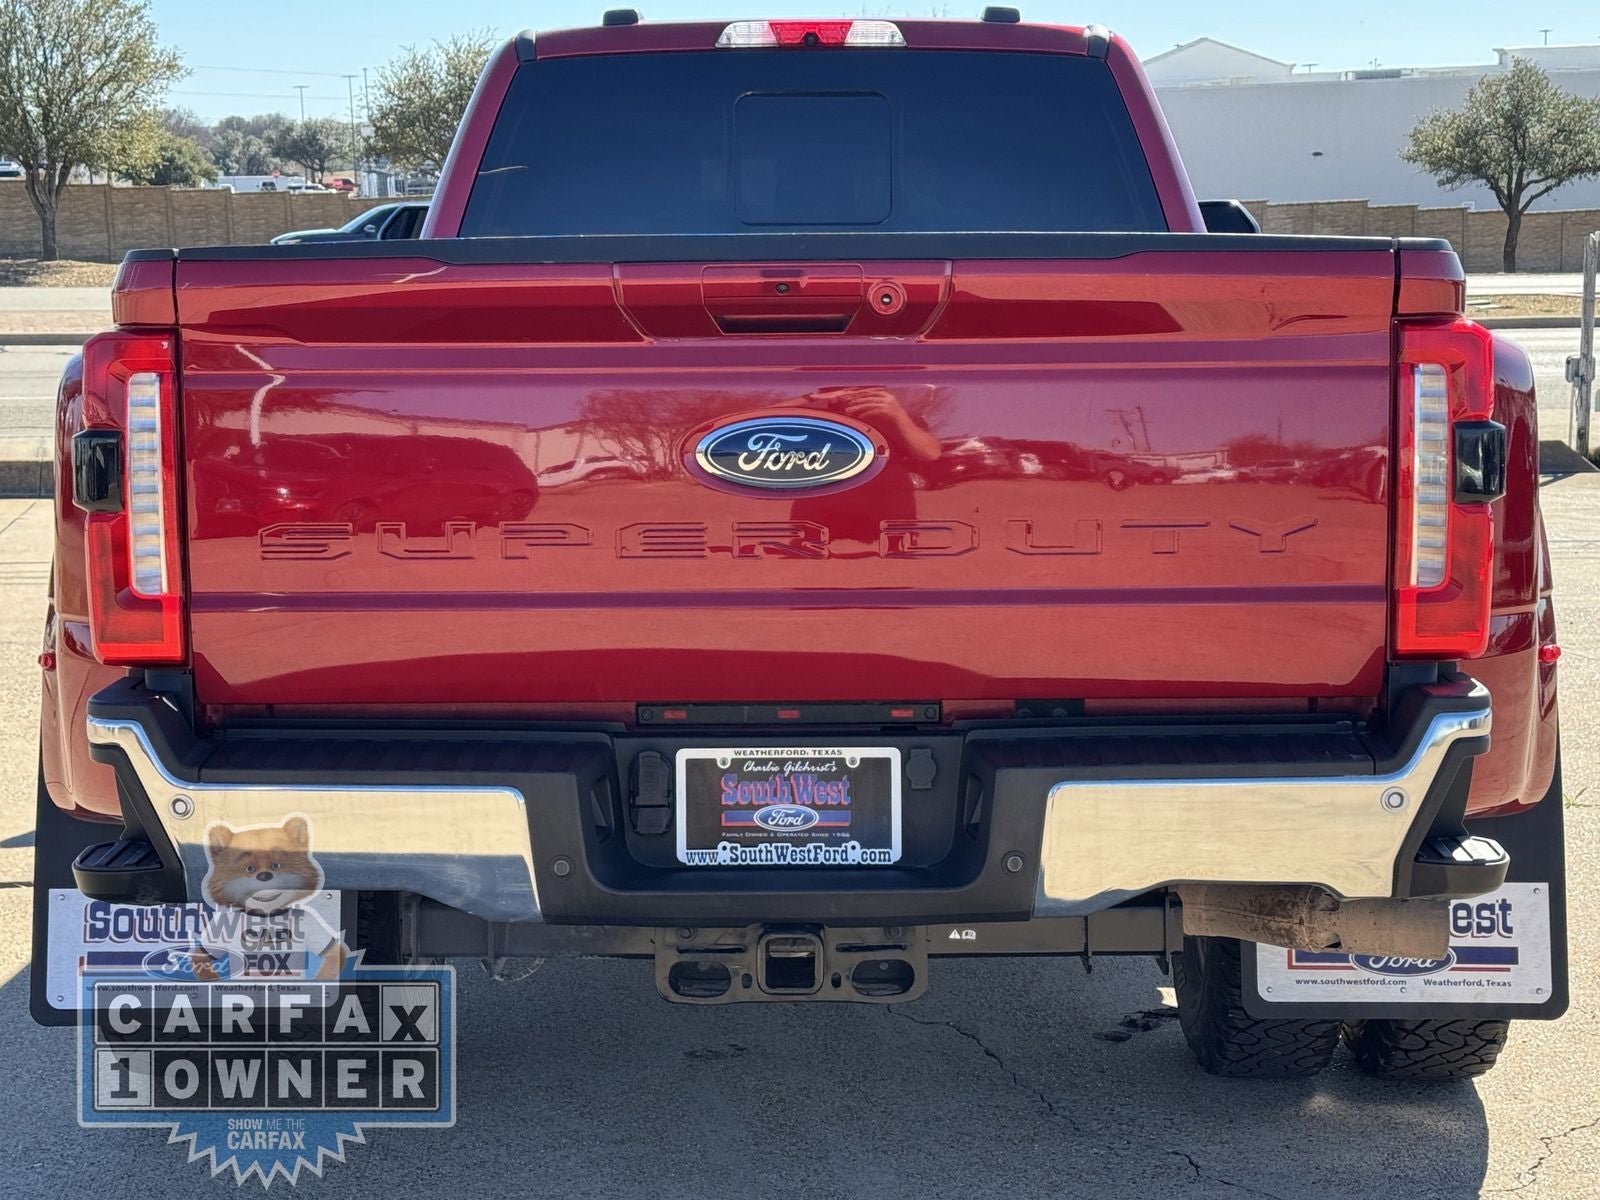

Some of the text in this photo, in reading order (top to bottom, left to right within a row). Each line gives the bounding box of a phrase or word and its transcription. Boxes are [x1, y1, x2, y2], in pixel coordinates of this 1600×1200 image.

[738, 433, 831, 471] Ford
[258, 519, 1319, 560] SUPER DUTY
[743, 760, 837, 777] Charlie Gilchrist's
[768, 809, 804, 826] Ford
[1450, 899, 1514, 938] est
[1295, 977, 1512, 988] www.southwestford.com Weatherford, Texas
